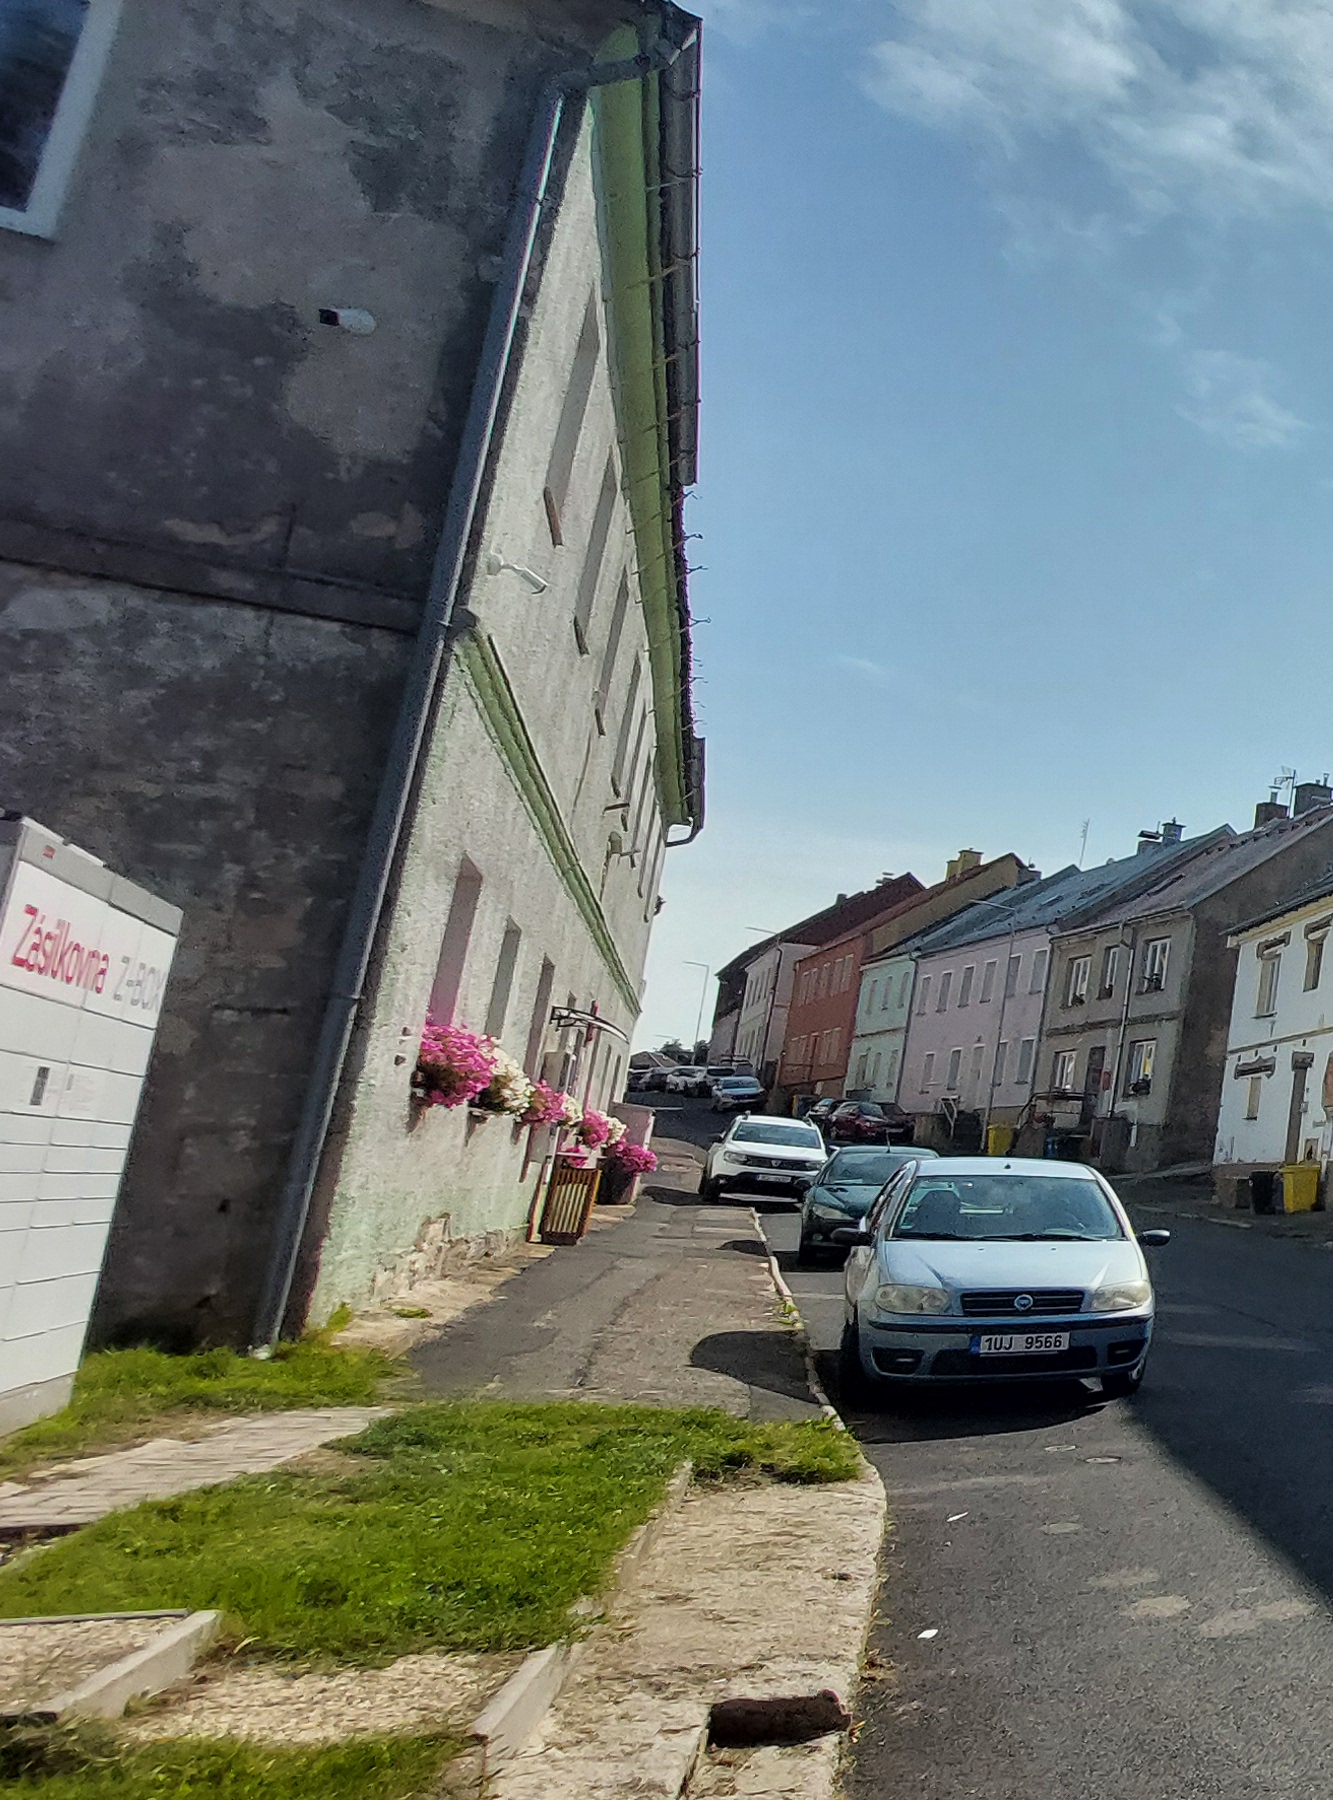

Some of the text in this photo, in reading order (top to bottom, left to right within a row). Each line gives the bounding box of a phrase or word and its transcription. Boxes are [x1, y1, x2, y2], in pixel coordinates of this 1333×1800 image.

[11, 904, 110, 994] Zásilkovna
[985, 1335, 1063, 1351] 1UJ 9566
